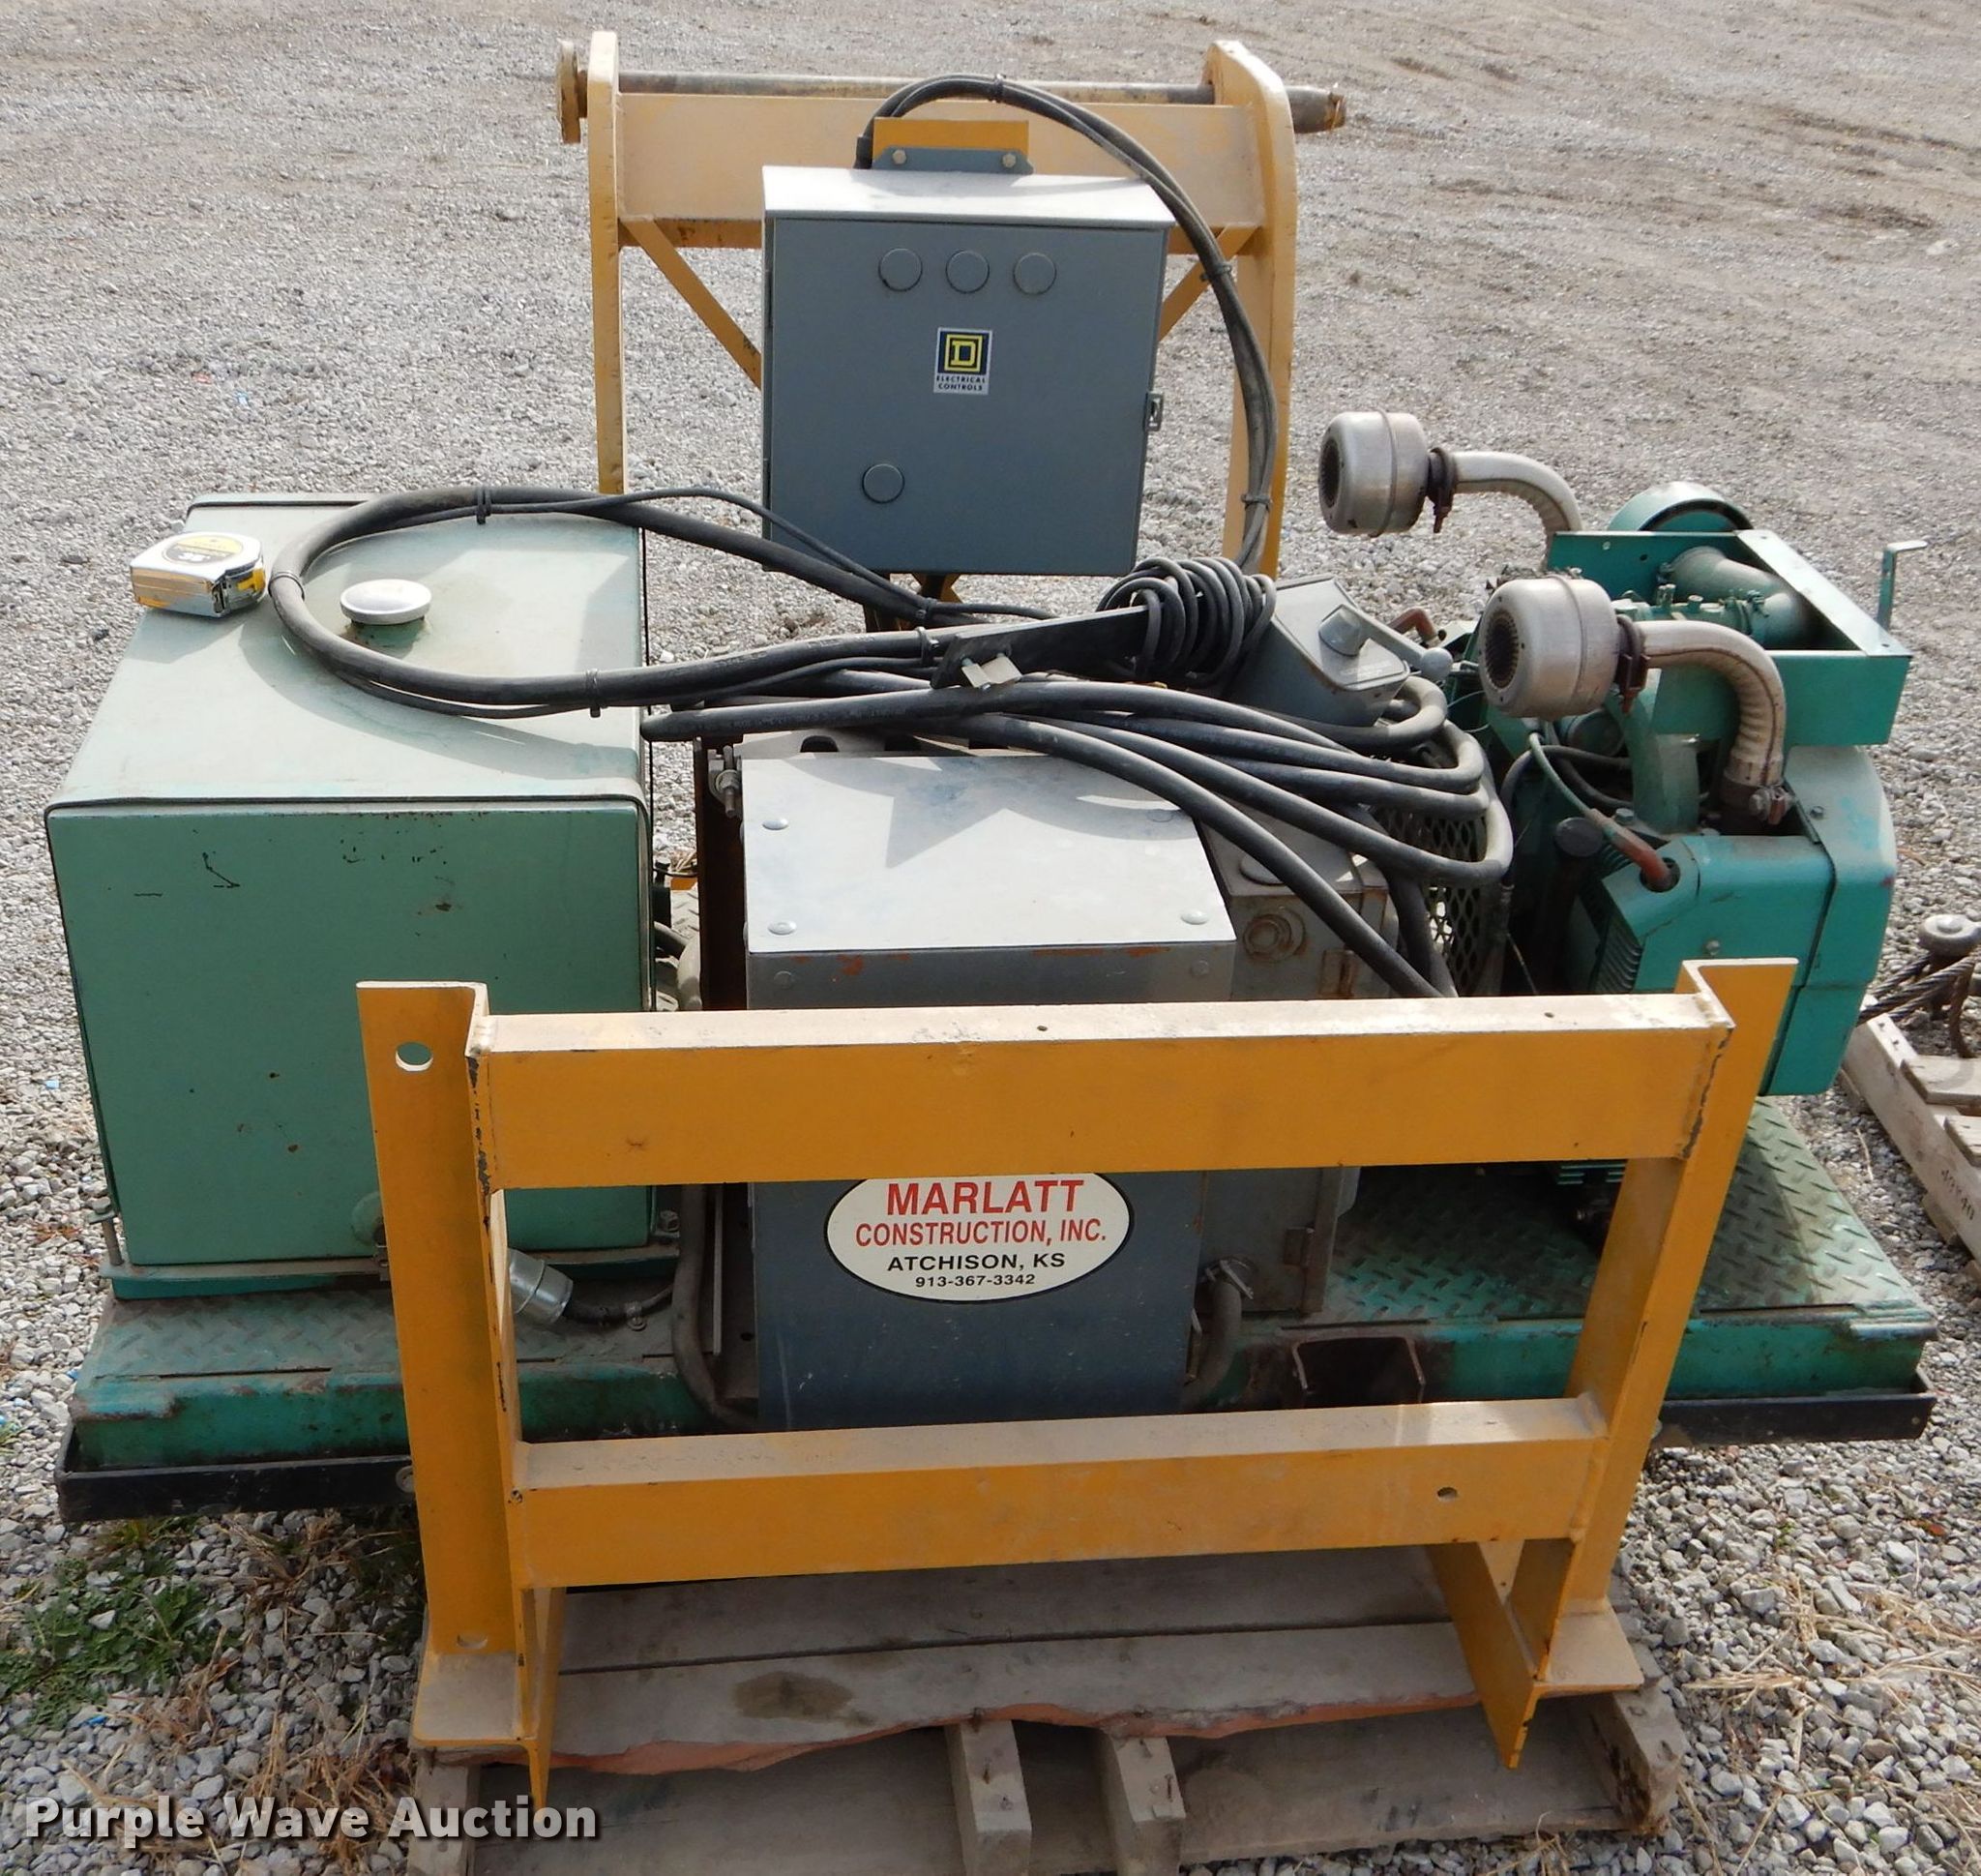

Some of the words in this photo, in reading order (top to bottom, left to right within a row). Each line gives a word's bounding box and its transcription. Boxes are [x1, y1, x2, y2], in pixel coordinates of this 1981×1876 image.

[887, 1179, 1084, 1216] MARLATT
[855, 1219, 1052, 1247] CONSTRUCTION,
[1060, 1218, 1107, 1242] INC.
[887, 1253, 1024, 1271] ATCHISON,
[1033, 1252, 1066, 1267] KS
[915, 1273, 1036, 1288] 913-367-3342
